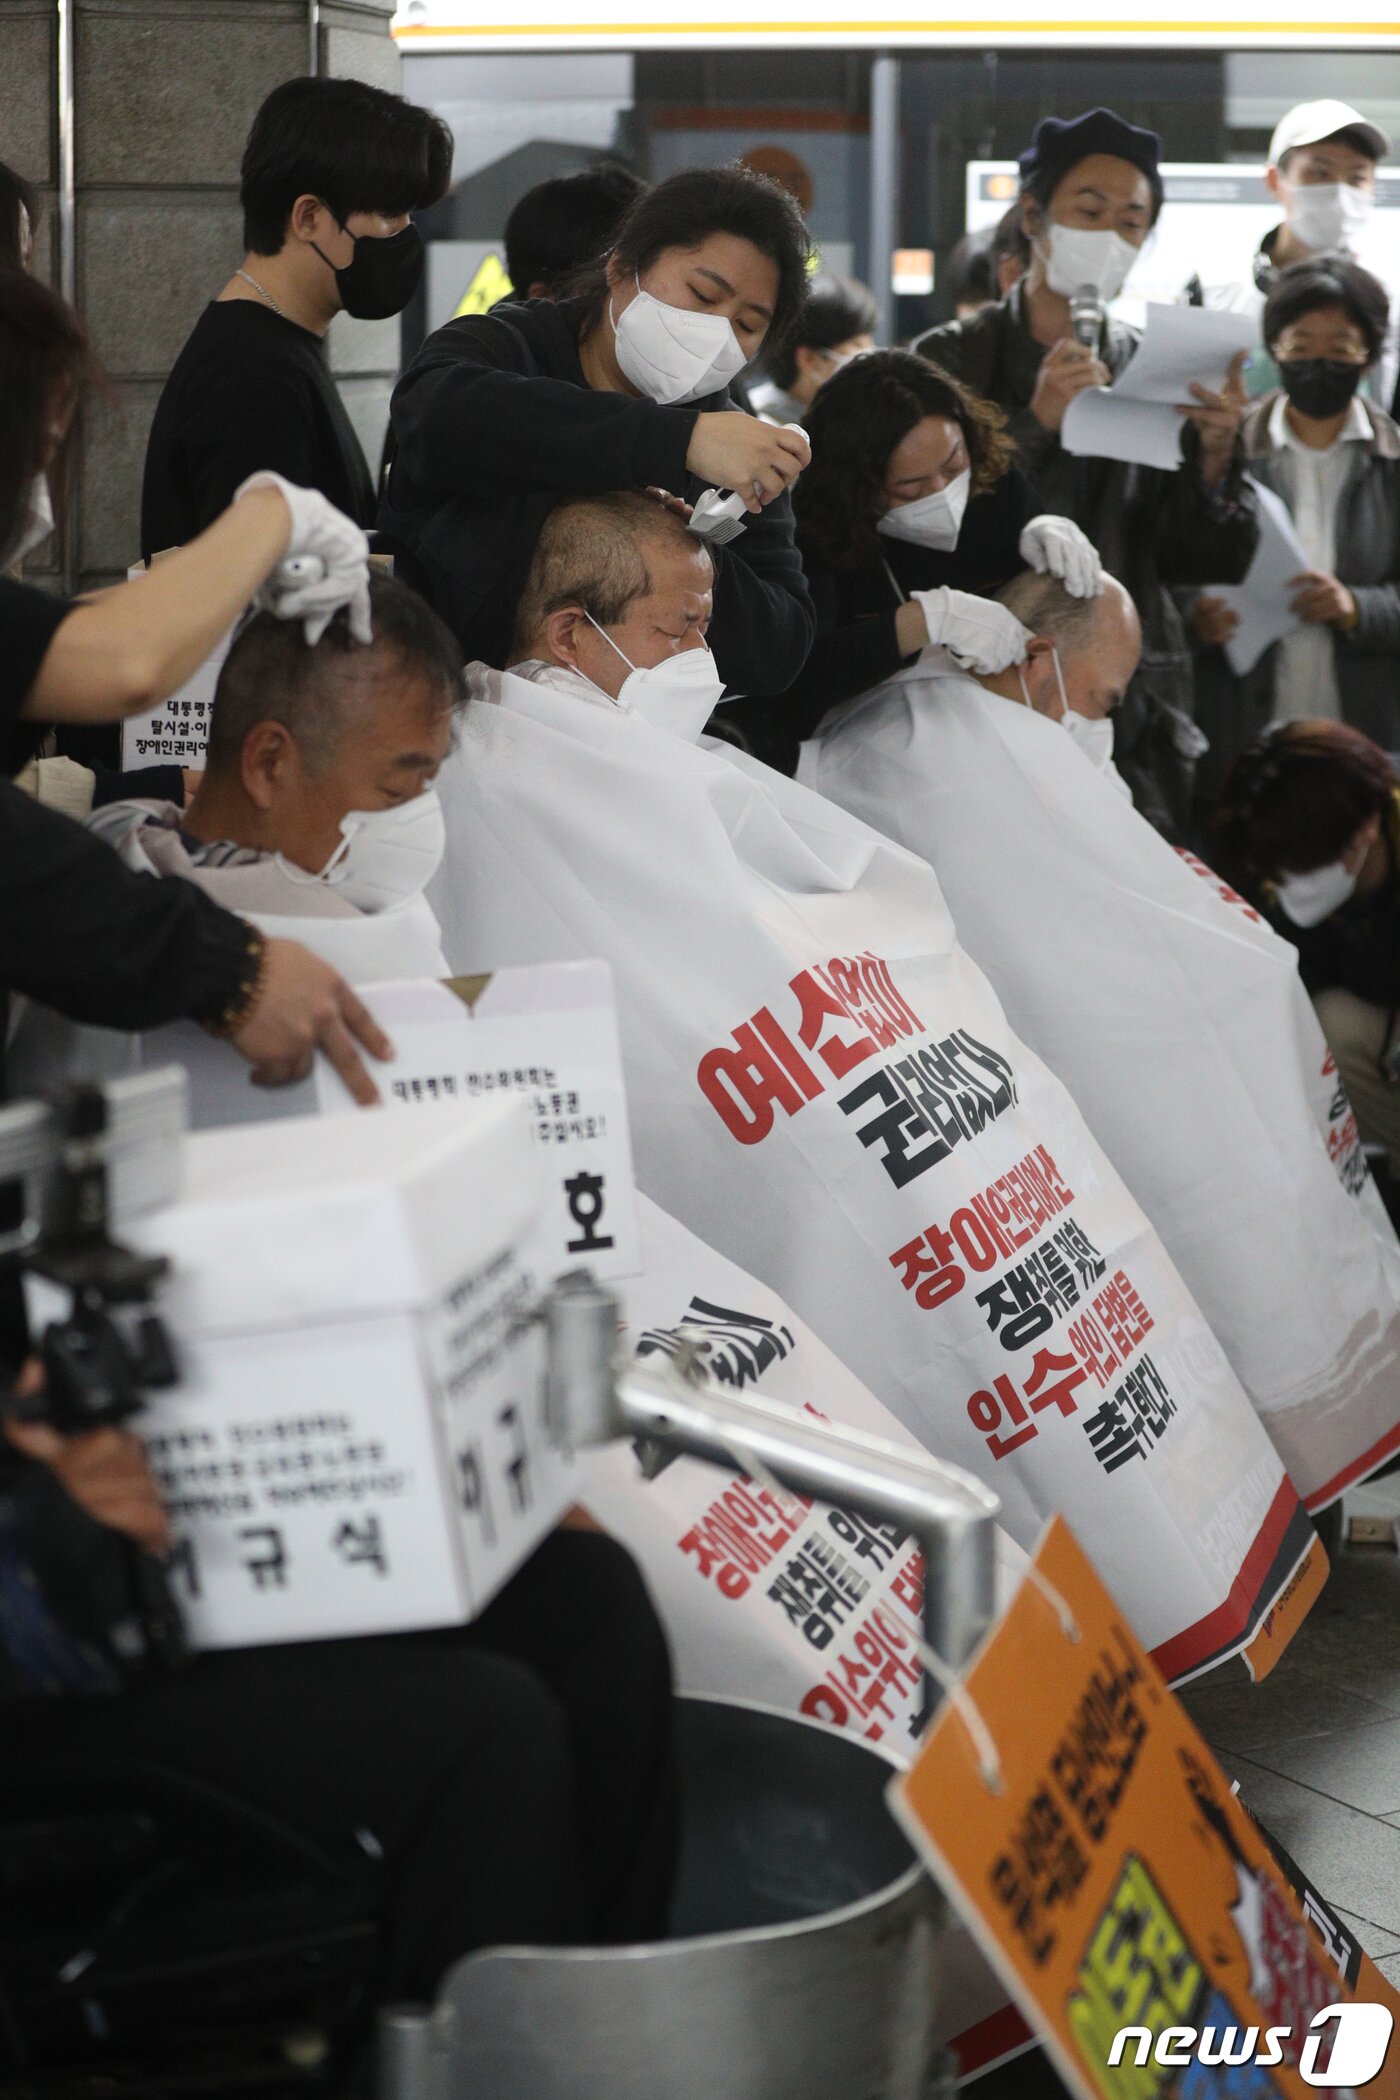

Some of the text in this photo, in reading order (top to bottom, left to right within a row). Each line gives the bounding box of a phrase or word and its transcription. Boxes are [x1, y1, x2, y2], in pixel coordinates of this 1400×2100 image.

[563, 1171, 615, 1253] 호
[888, 1144, 1076, 1310] 장애인권리예산
[975, 1217, 1107, 1352] 쟁취를 위한
[966, 1269, 1155, 1462] 인수위의 답변을
[1082, 1353, 1178, 1474] 촉구한다!
[766, 1531, 872, 1651] 쟁취를
